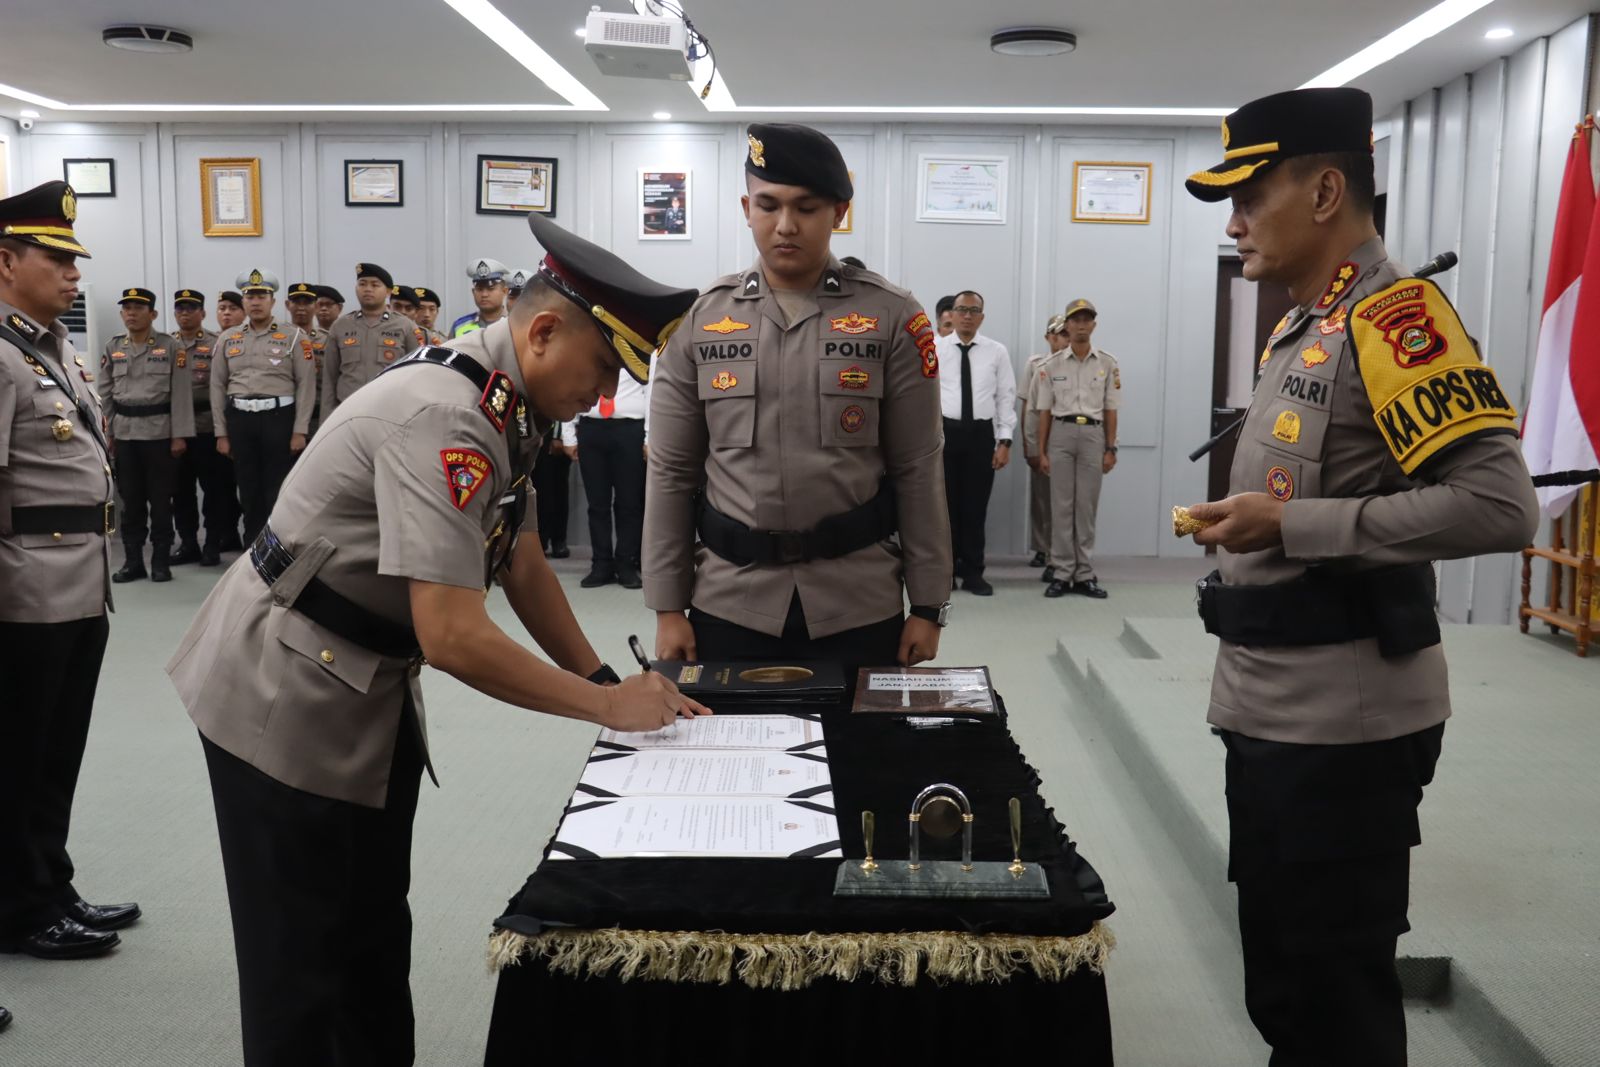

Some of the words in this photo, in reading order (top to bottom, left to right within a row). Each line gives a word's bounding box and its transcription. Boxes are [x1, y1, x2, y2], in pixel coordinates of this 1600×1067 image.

[699, 343, 752, 361] VALDO
[825, 342, 882, 359] POLRI
[1281, 375, 1328, 405] POLRI
[1380, 401, 1423, 455] KA
[1413, 371, 1475, 427] OPS
[445, 453, 464, 462] OPS
[466, 455, 488, 471] POLRI
